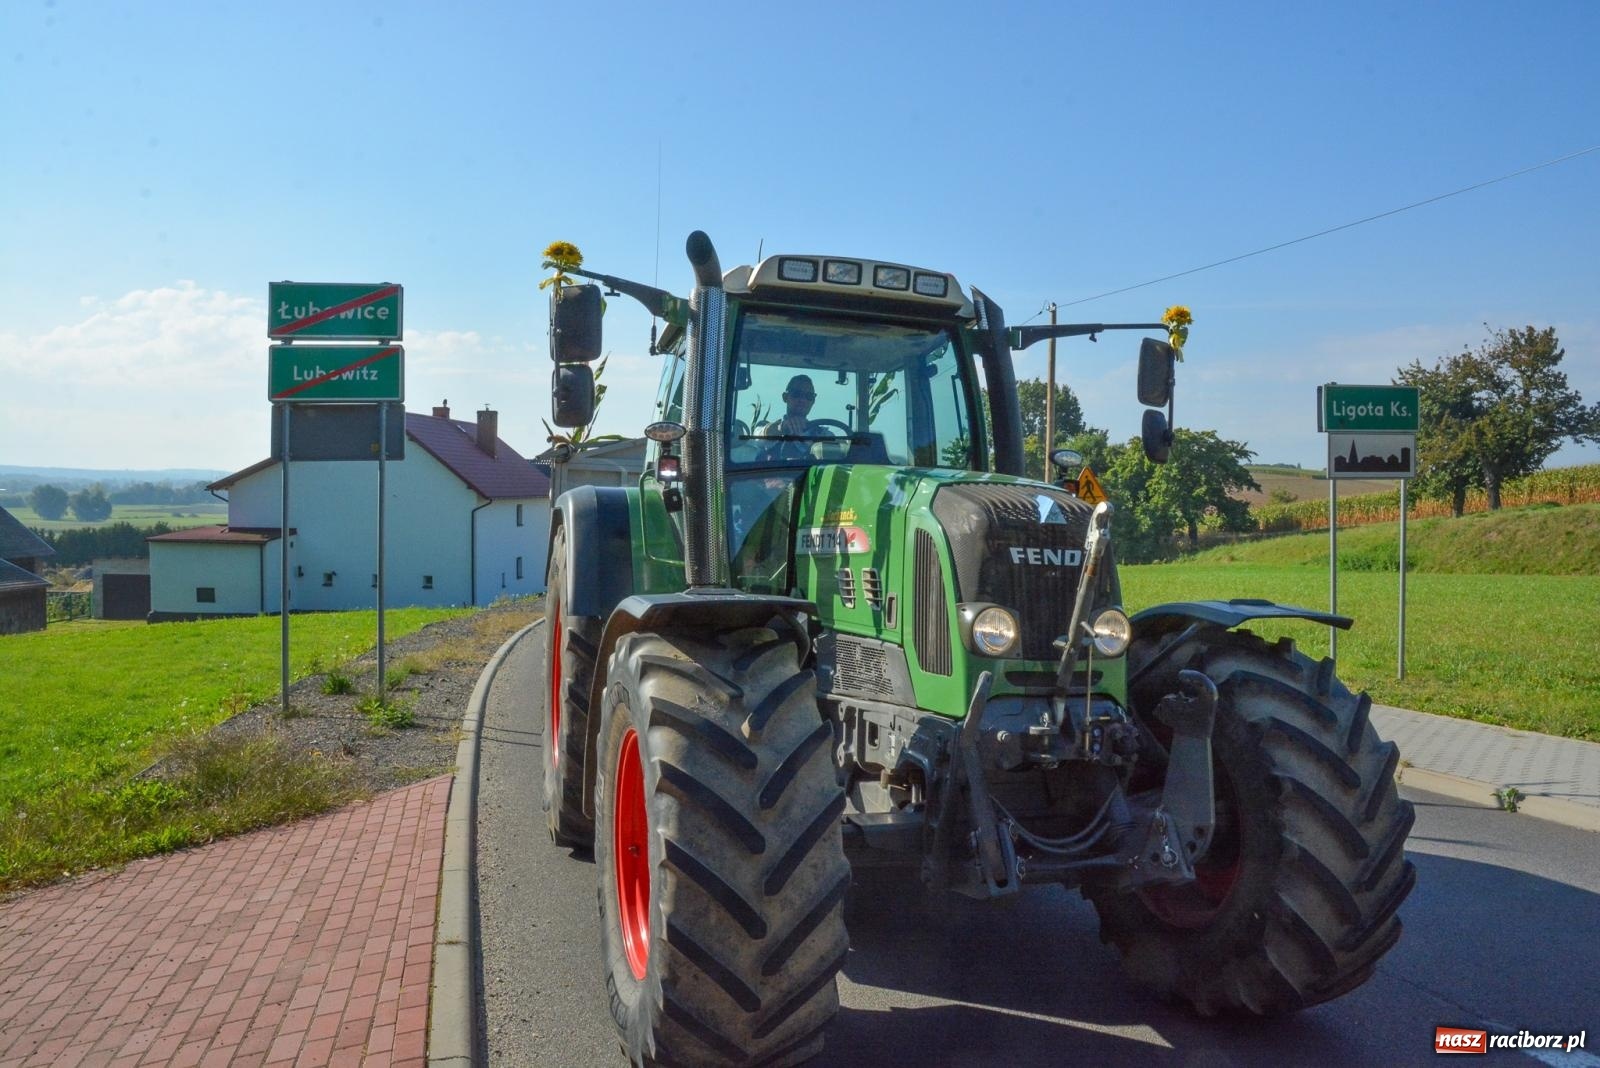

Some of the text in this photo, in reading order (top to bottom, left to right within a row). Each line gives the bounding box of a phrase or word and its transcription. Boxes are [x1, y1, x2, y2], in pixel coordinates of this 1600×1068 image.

[1333, 400, 1412, 421] Ligota Ks.
[1009, 546, 1083, 567] FEND
